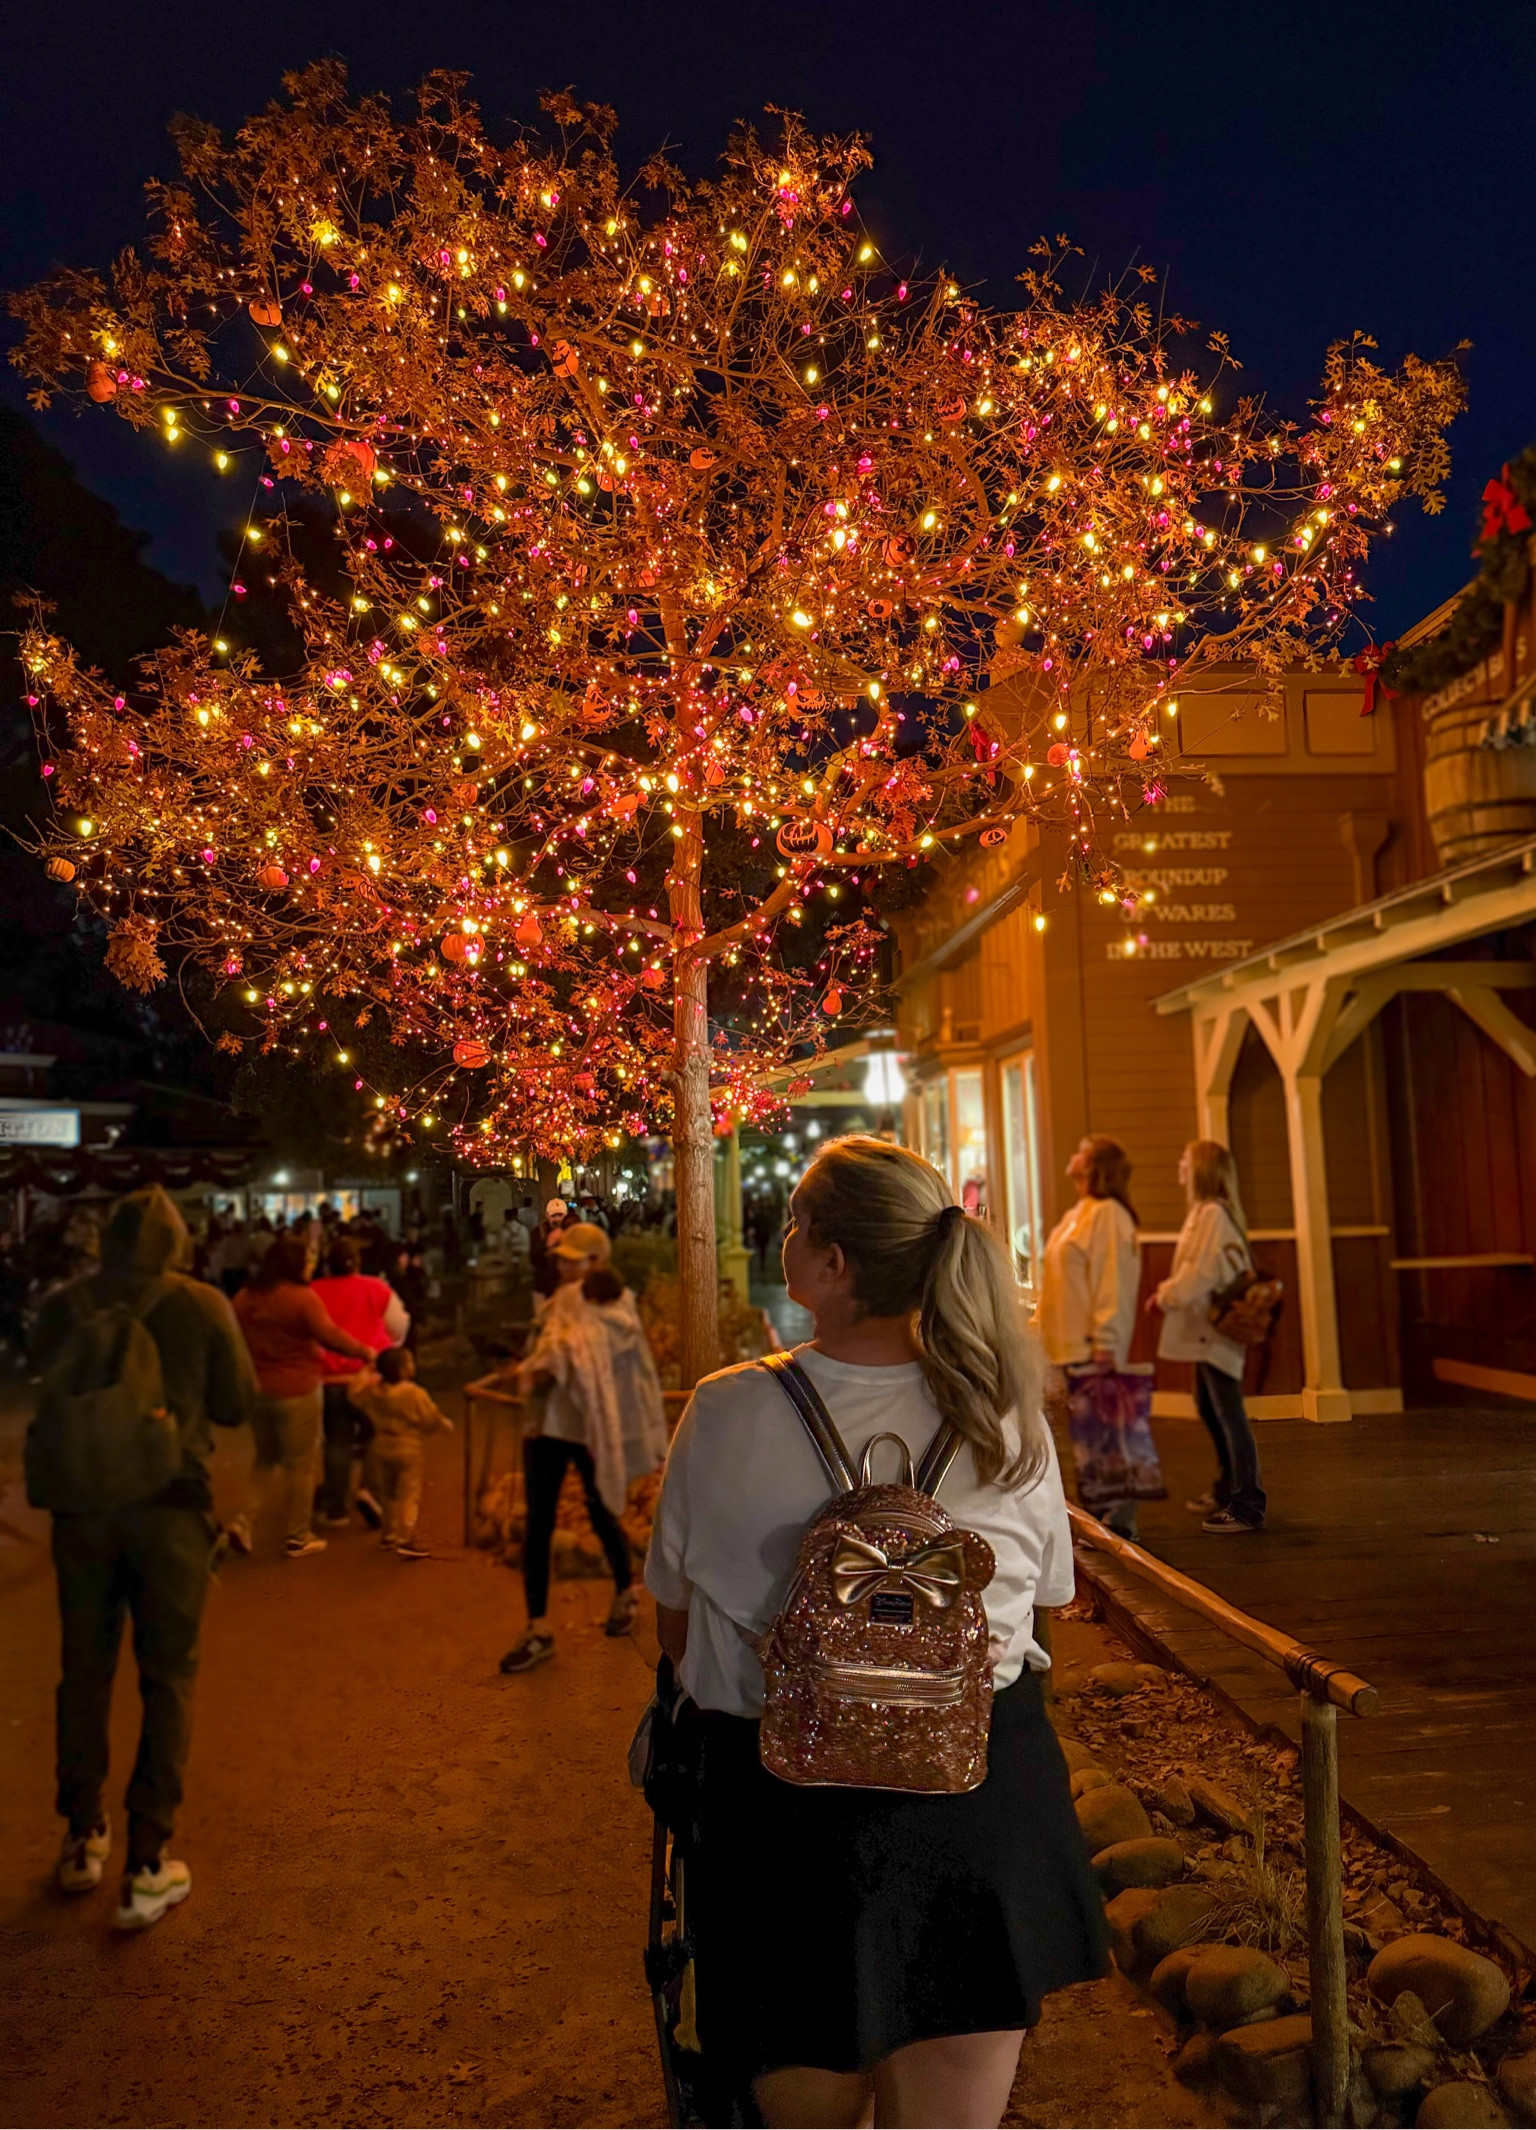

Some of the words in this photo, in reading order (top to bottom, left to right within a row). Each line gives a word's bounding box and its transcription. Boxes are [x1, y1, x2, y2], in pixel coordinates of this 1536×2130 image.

[1112, 831, 1232, 850] GREATEST
[1122, 867, 1229, 886] ROUNDUP
[1152, 903, 1237, 923] WARES
[1188, 940, 1253, 960] WEST
